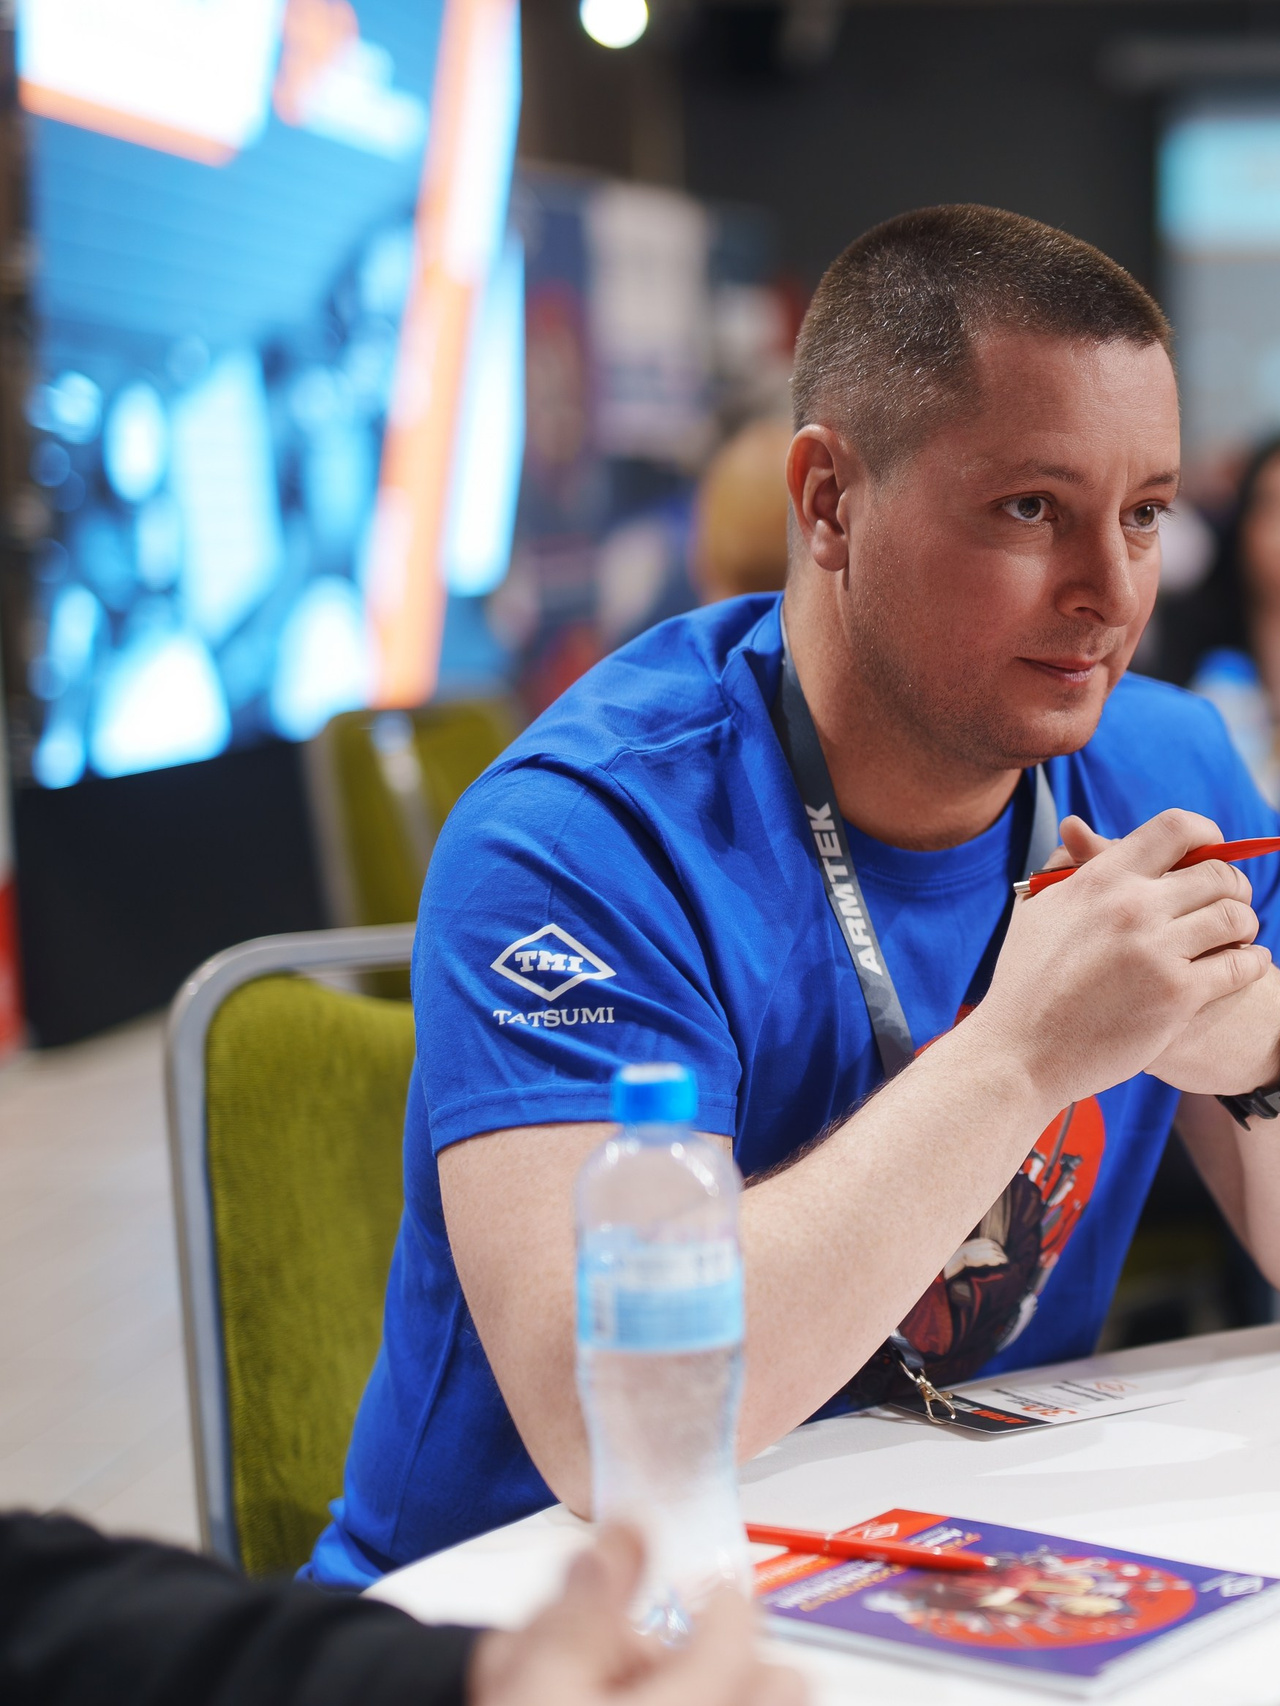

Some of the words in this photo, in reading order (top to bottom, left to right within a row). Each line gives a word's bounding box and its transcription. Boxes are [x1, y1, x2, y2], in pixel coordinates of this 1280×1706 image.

[804, 801, 883, 977] ARMTEK
[514, 950, 584, 973] TMI
[492, 1006, 616, 1029] TATSUMI
[949, 1400, 1029, 1424] ARMTE
